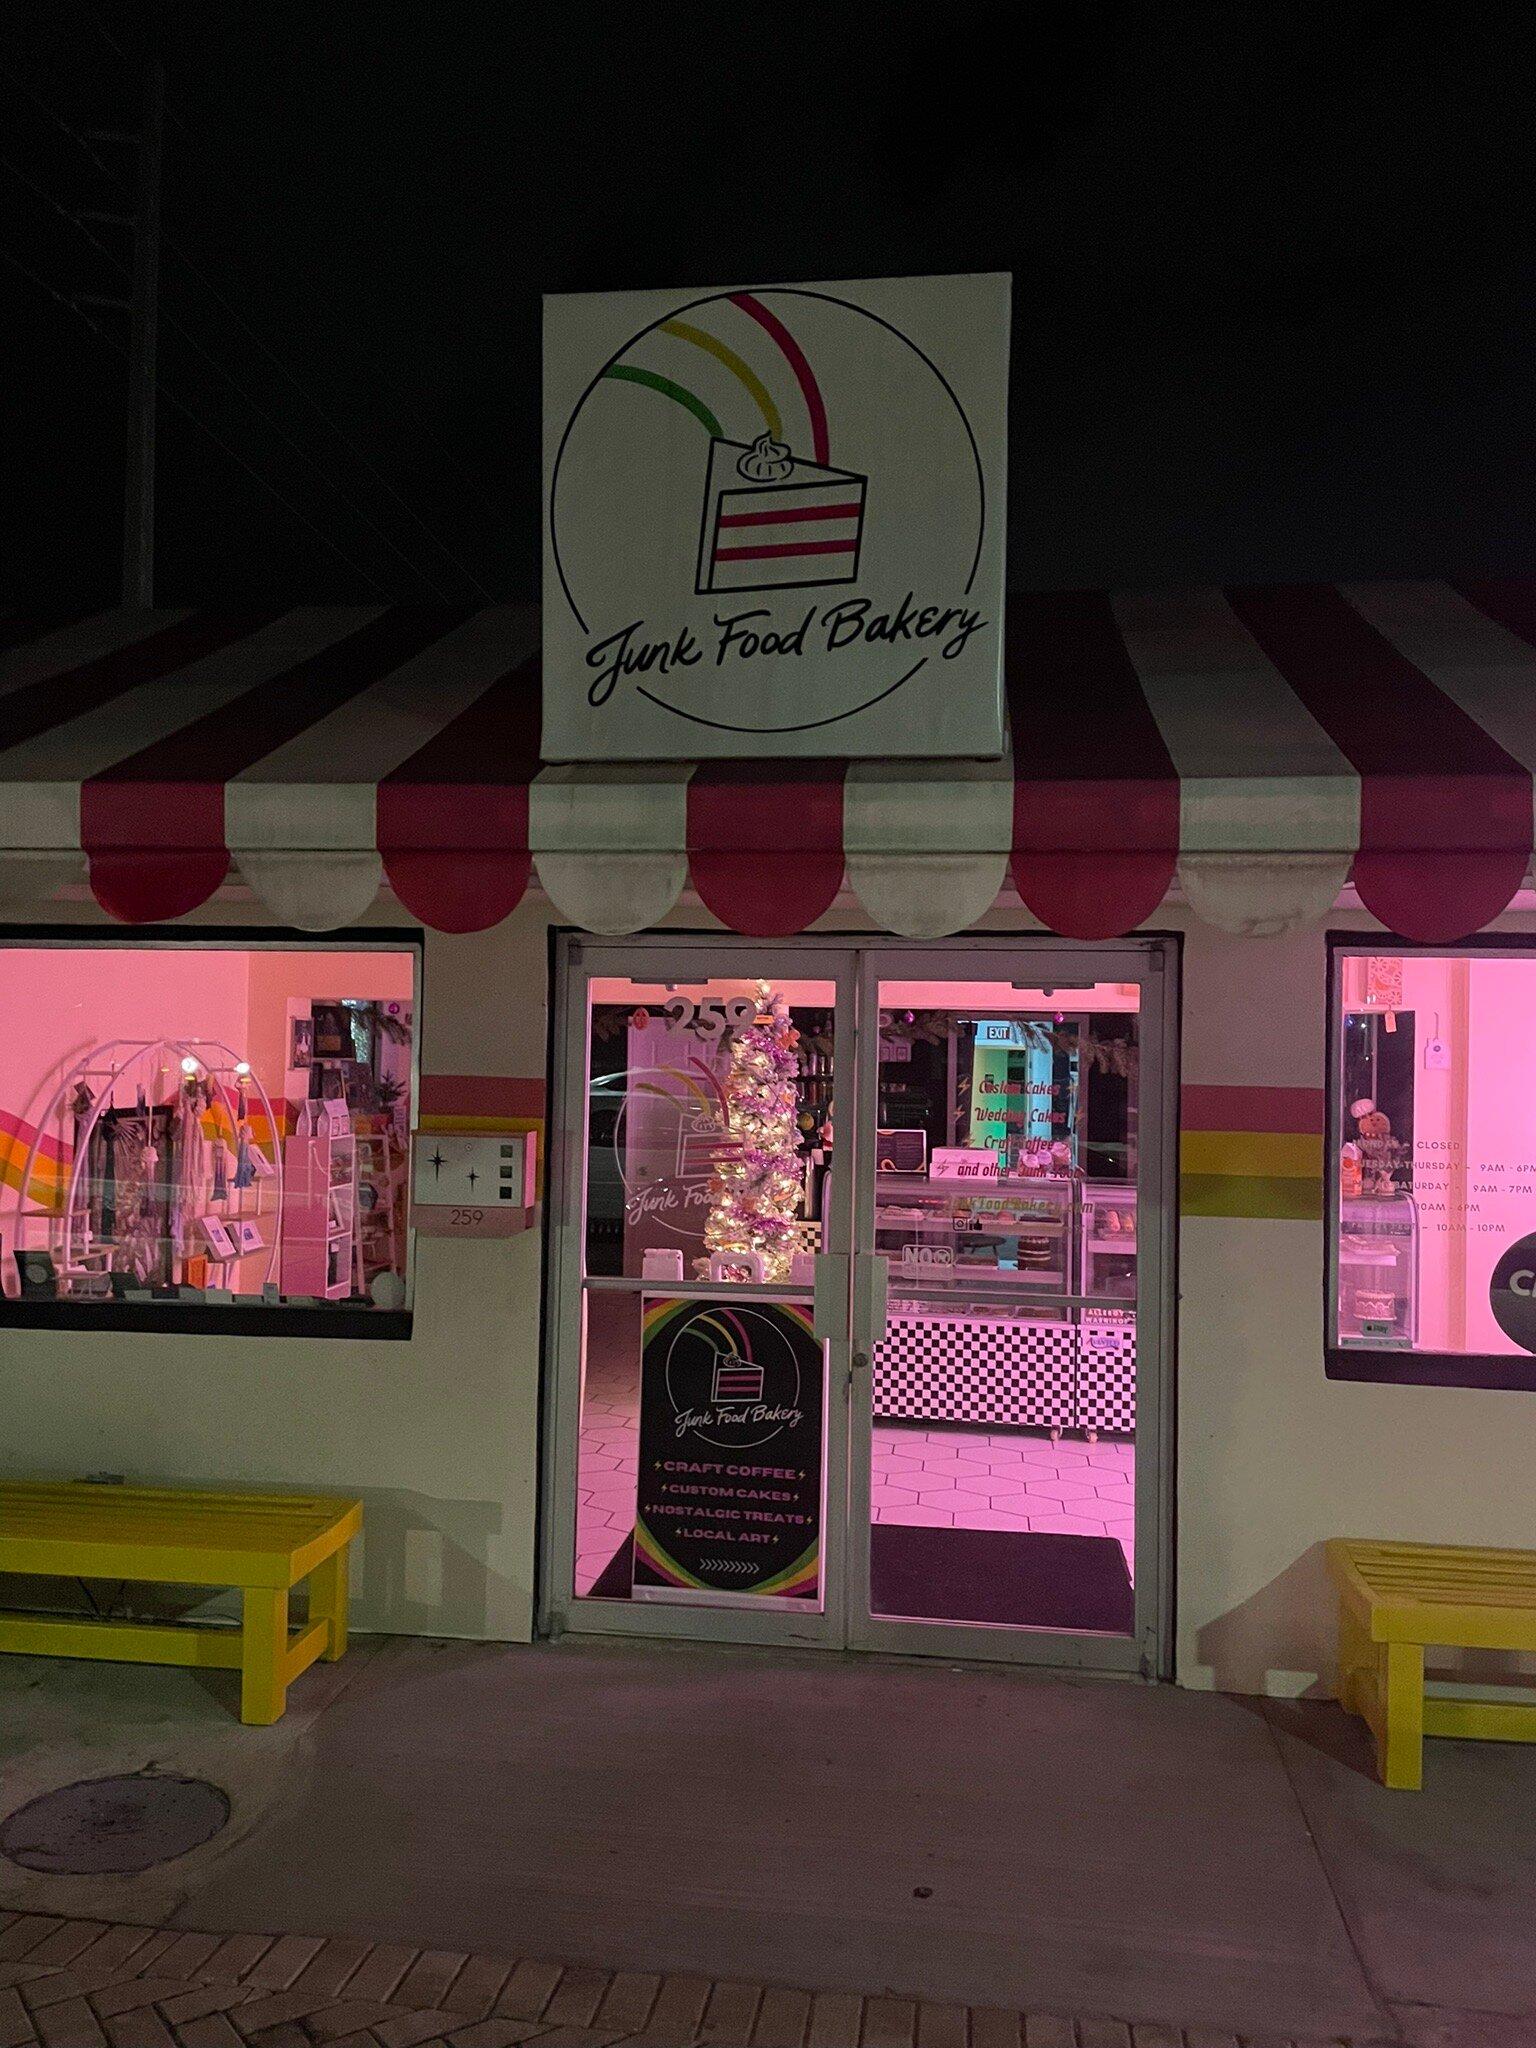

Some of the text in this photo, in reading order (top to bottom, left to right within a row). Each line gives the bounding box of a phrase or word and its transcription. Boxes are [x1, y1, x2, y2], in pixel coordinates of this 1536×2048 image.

[586, 592, 989, 706] Junk Food Bakery
[664, 996, 758, 1041] 259
[988, 1027, 1008, 1039] EXIT
[1025, 1081, 1060, 1095] Cakes
[1416, 1141, 1460, 1150] CLOSED
[957, 1163, 979, 1176] and
[982, 1164, 1010, 1177] other
[1354, 1158, 1461, 1171] UESDAY-THURSDAY
[1480, 1164, 1505, 1173] 9AM
[1516, 1165, 1536, 1173] 6PM
[1473, 1184, 1498, 1193] 9AM
[1508, 1185, 1532, 1194] 7PM
[627, 1187, 679, 1226] Junk
[1457, 1202, 1480, 1212] 6PM
[451, 1209, 484, 1225] 259
[1437, 1223, 1467, 1232] 10AM
[1477, 1223, 1505, 1232] 10PM
[674, 1404, 804, 1437] Junk Food Bakery
[663, 1460, 797, 1480] CRAFT COFFEE
[669, 1483, 792, 1502] CUSTOM CAKES
[652, 1504, 805, 1525] NOSTALGIC TREATS
[683, 1527, 771, 1544] LOCAL ART
